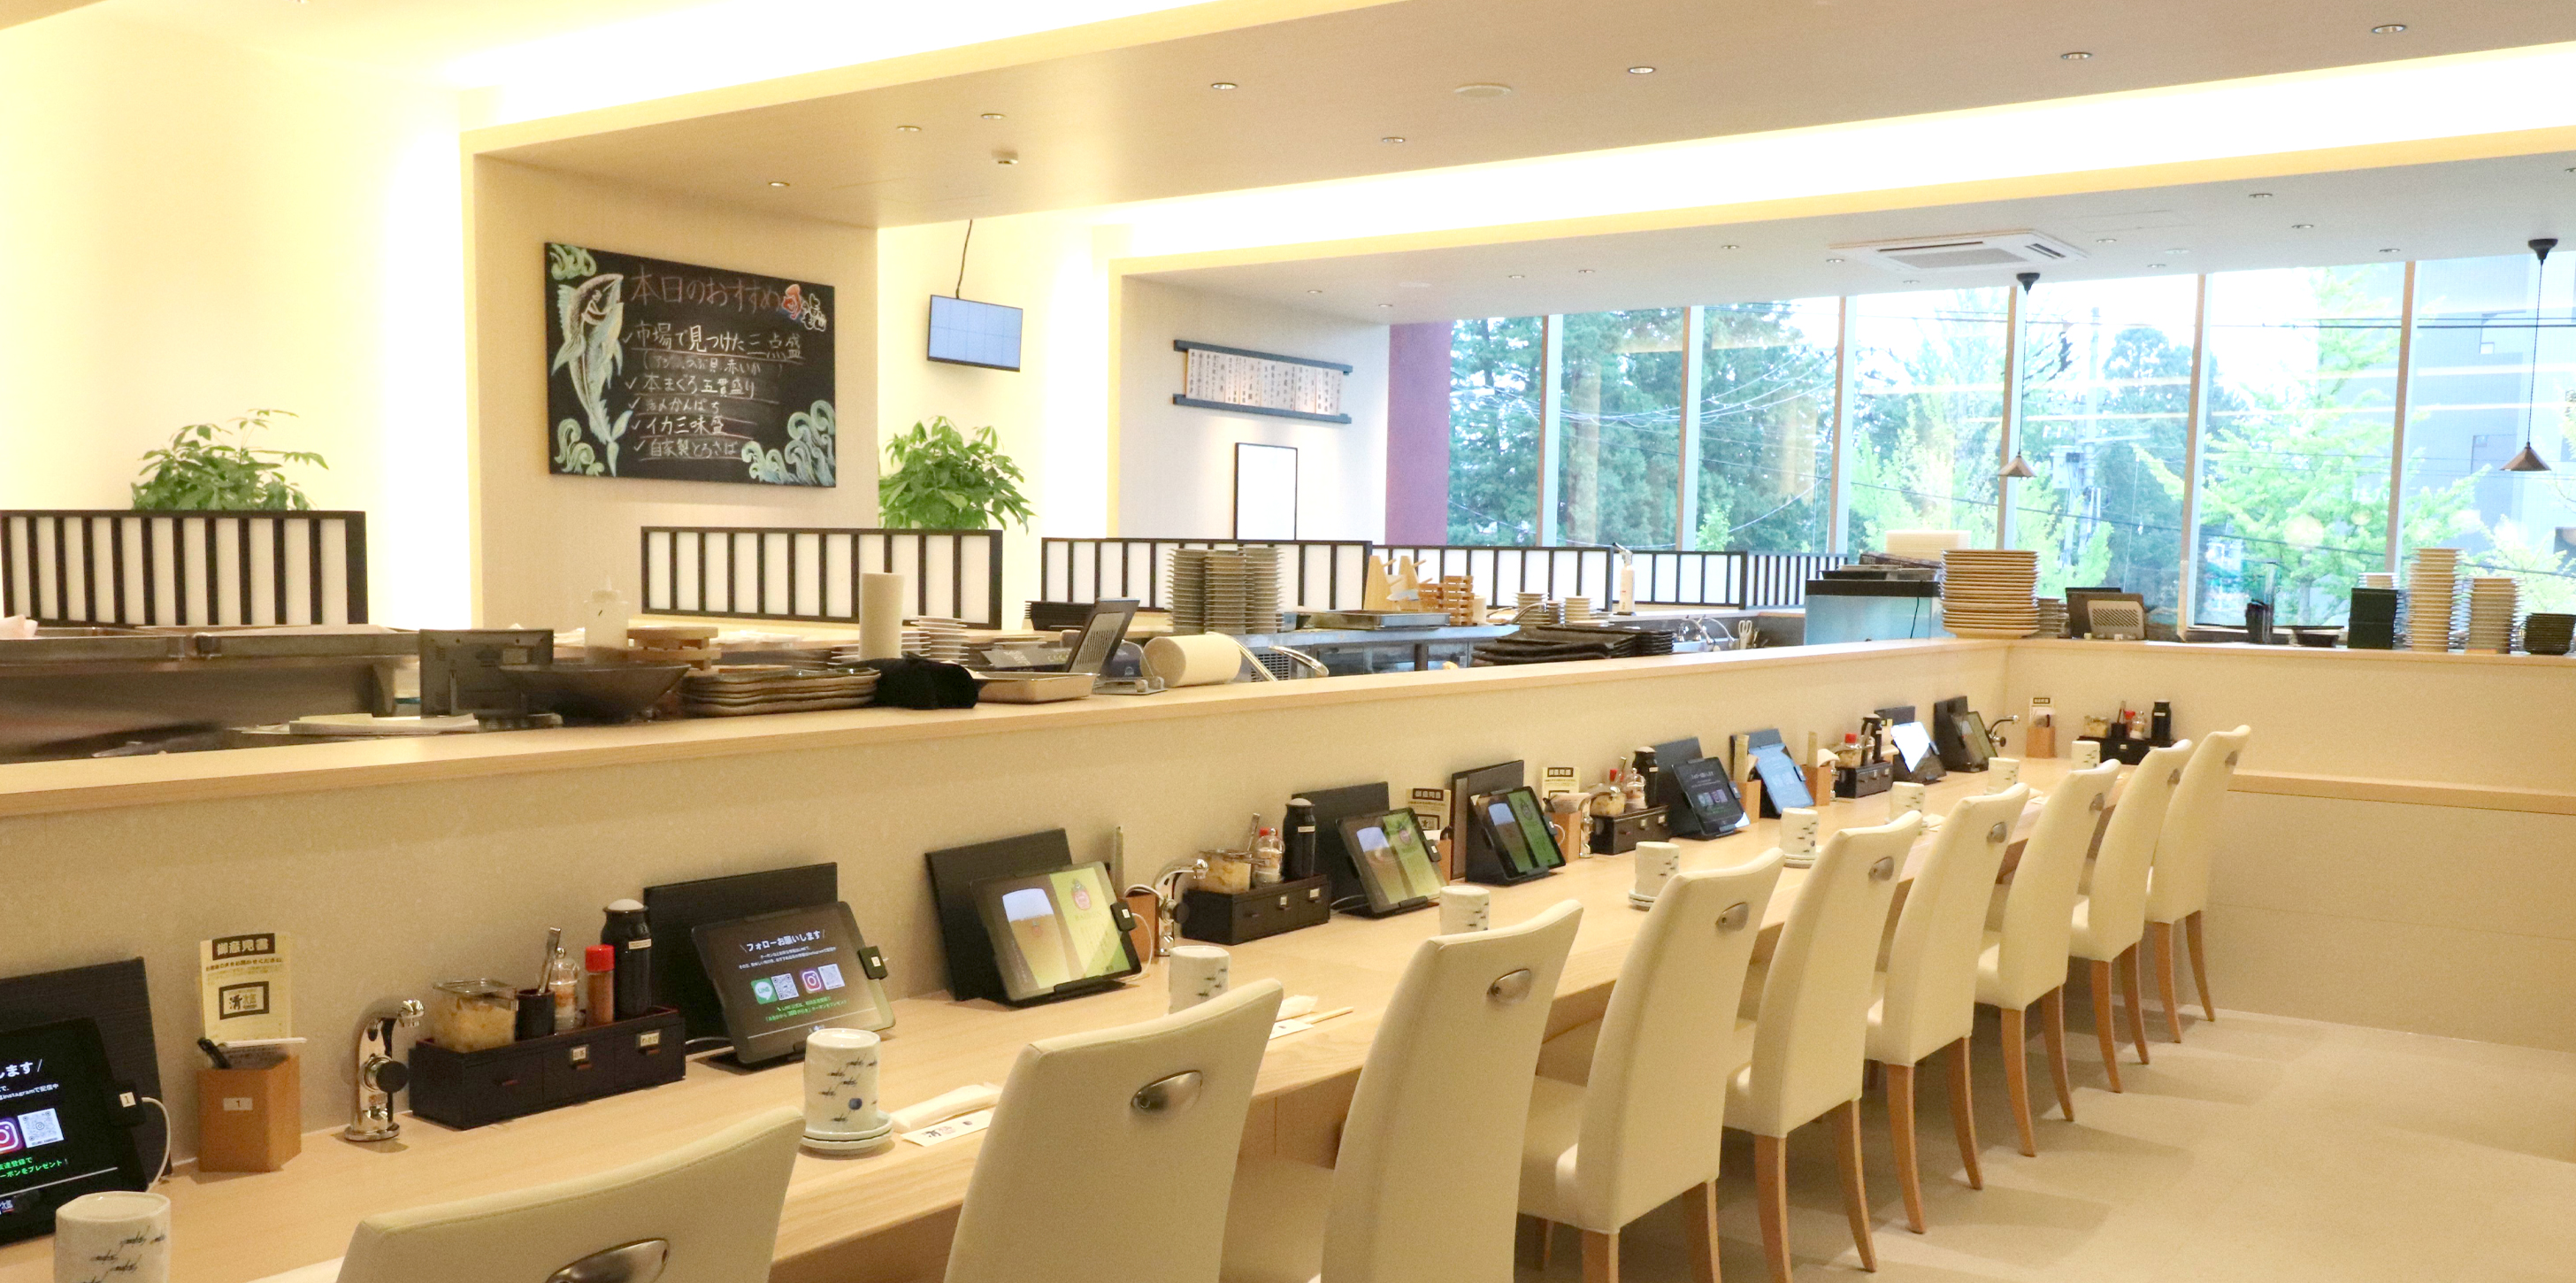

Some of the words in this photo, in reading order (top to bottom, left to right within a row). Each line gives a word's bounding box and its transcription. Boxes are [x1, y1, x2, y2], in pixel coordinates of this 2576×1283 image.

[631, 265, 781, 312] 本日のおすすめ
[642, 372, 755, 398] 本まぐろ五貫盛り
[646, 415, 724, 435] イカ三味盛
[747, 930, 821, 952] フォローお願いします
